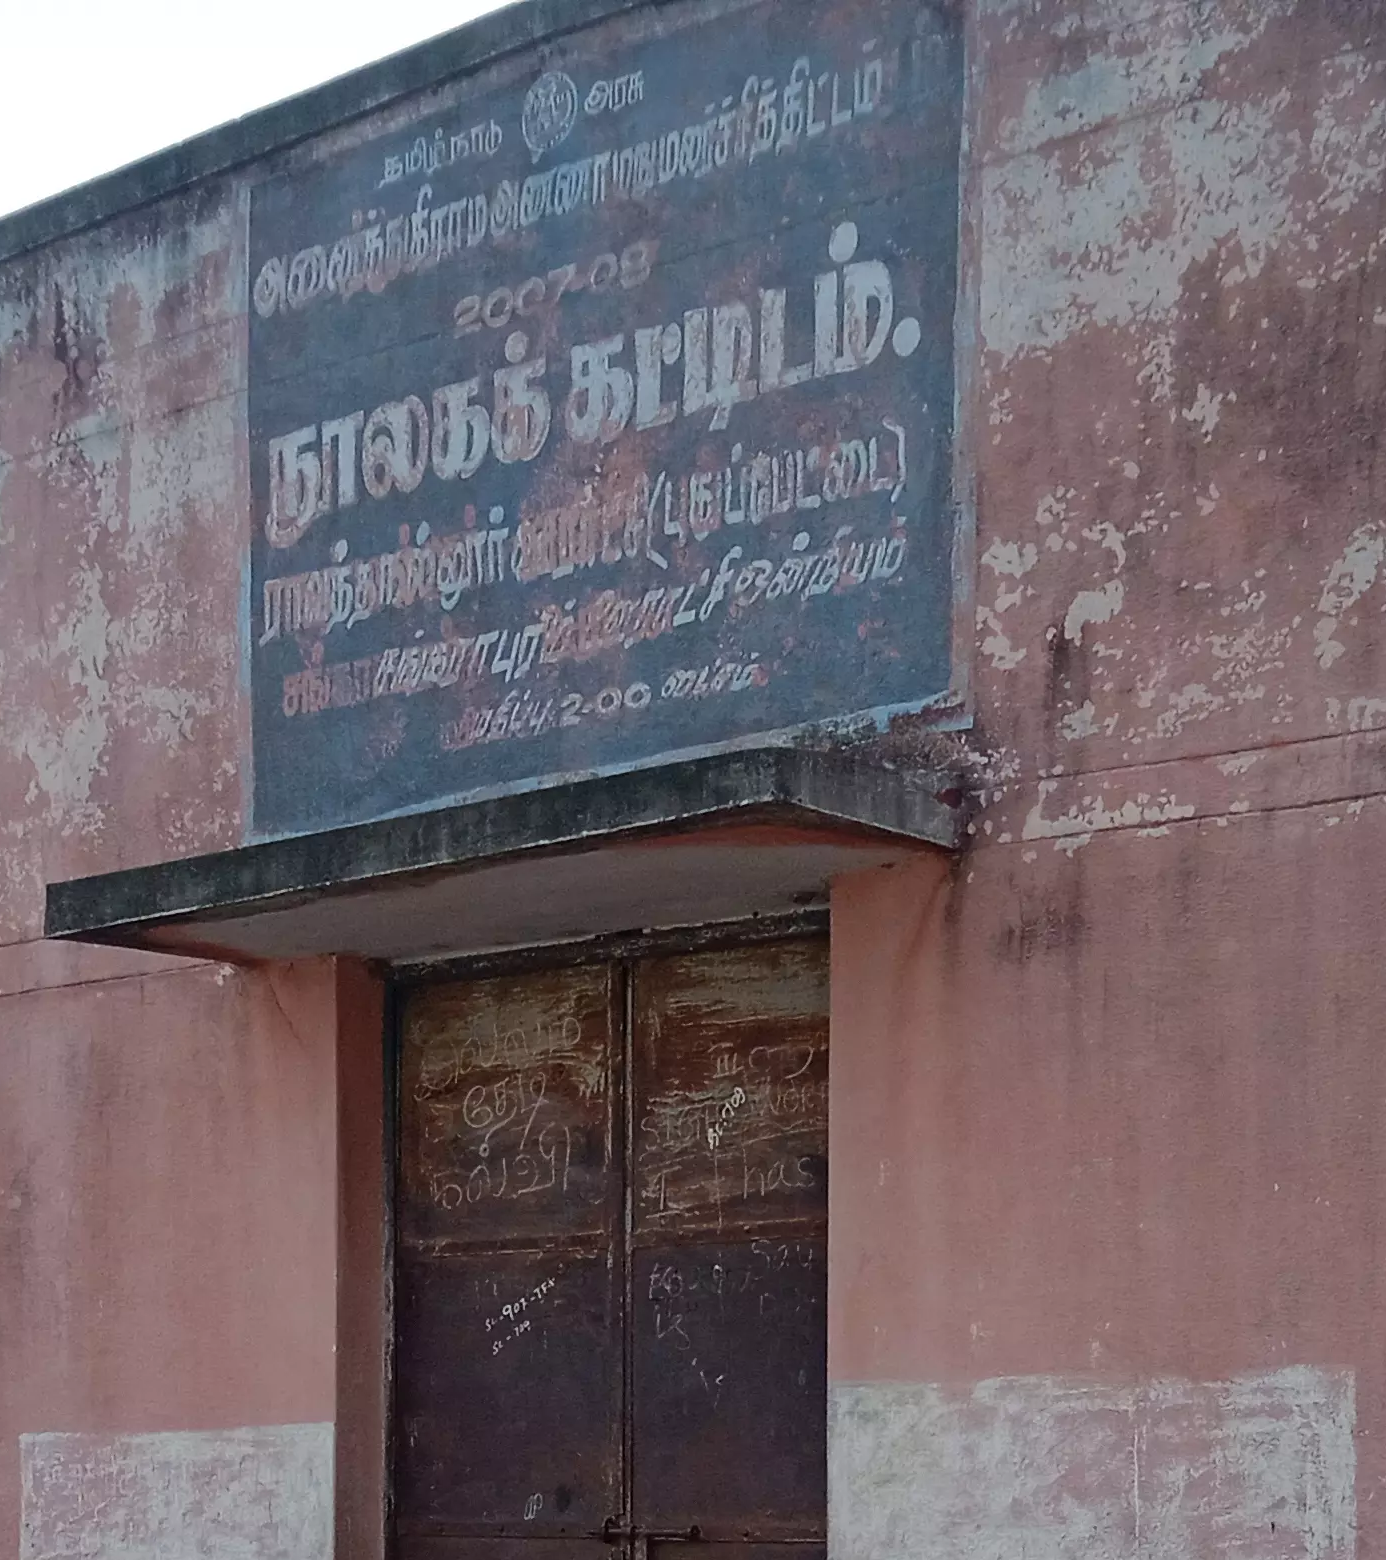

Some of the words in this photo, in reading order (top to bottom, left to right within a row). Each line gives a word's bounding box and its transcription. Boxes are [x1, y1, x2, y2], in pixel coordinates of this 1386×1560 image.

[378, 119, 503, 189] தமிழ்நாடு
[584, 70, 645, 115] அரசு
[264, 330, 551, 549] நூலகக்
